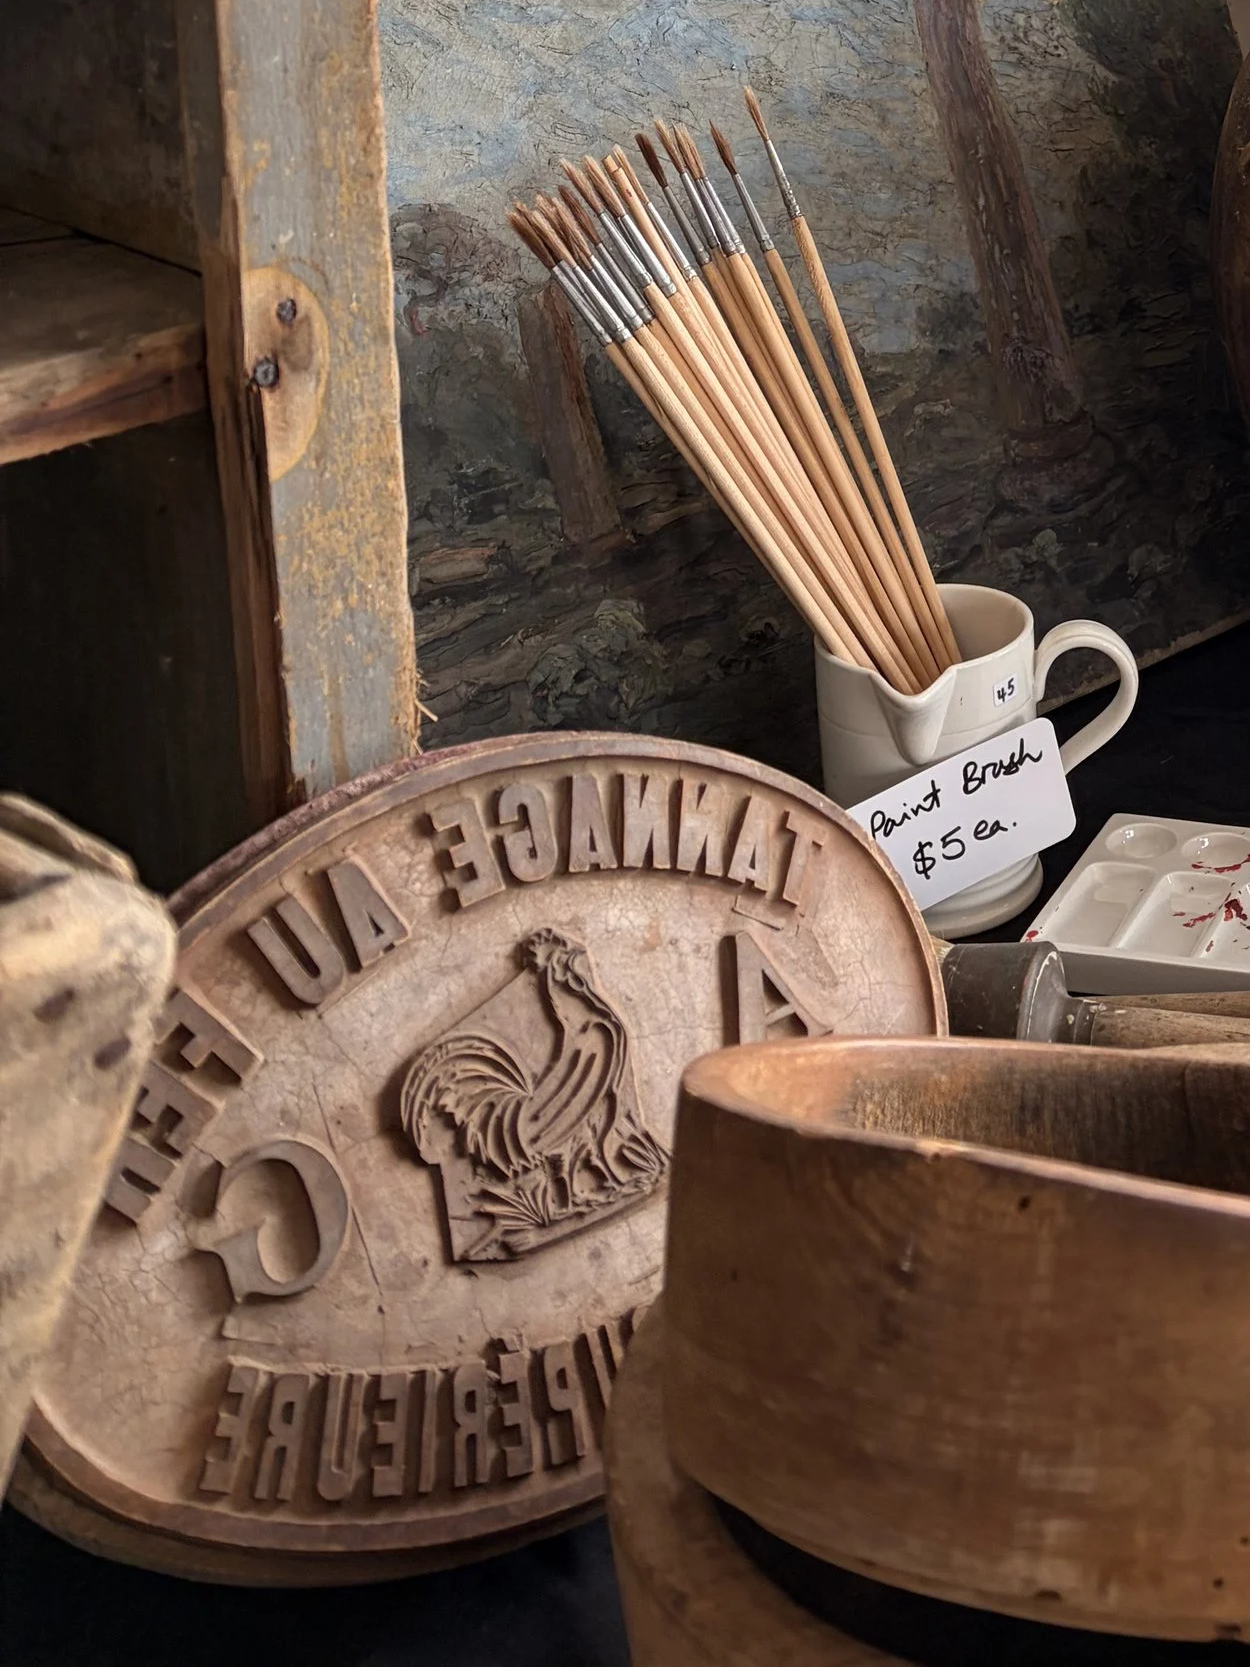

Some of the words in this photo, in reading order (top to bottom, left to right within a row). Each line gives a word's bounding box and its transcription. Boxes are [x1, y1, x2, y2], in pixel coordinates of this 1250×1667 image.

[996, 678, 1016, 704] 45
[869, 780, 942, 840] Paint
[963, 738, 1043, 796] Brush
[912, 825, 967, 880] $5
[973, 817, 1018, 840] ea.
